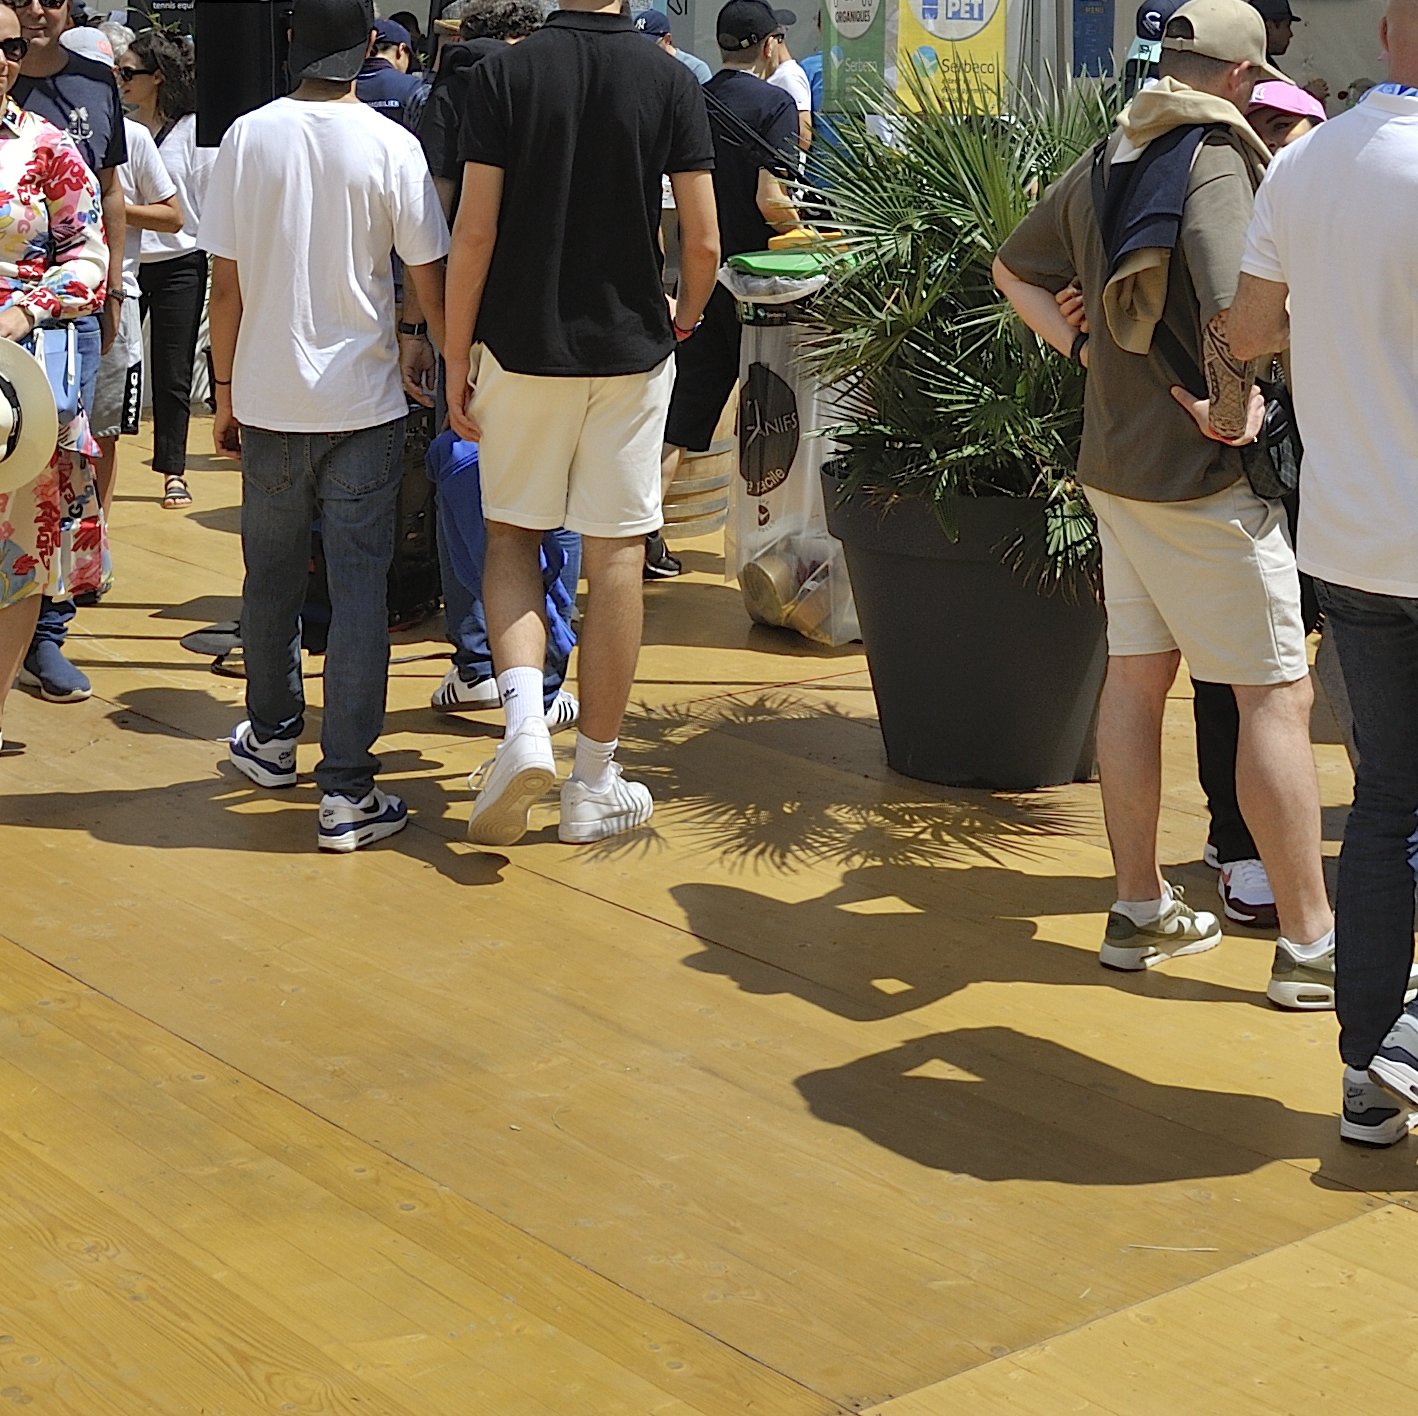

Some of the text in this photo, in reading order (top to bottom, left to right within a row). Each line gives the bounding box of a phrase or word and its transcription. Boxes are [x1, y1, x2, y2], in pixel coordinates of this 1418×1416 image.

[153, 0, 195, 12] tennis equi
[835, 10, 871, 23] ORGANIQUES
